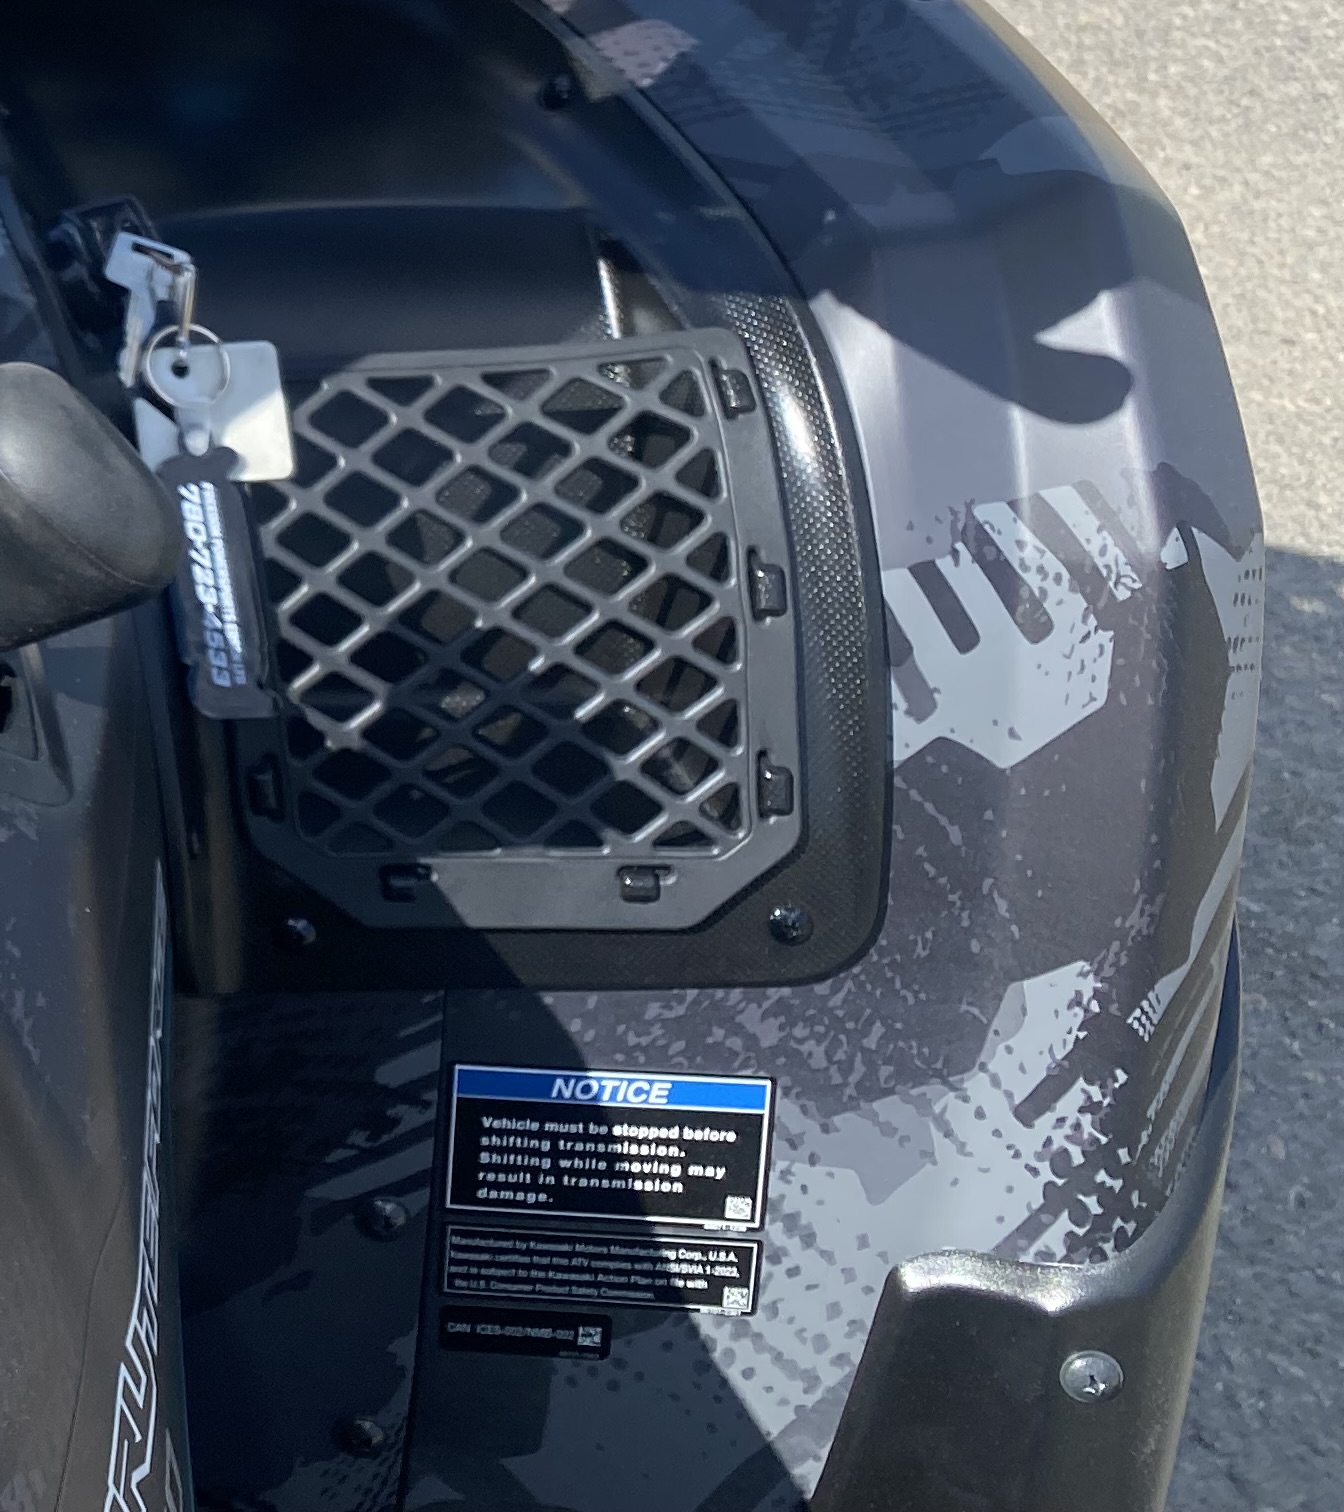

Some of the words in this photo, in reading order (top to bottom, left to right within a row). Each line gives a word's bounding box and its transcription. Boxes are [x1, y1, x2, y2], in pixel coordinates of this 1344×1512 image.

[551, 1078, 672, 1104] NOTICE
[482, 1117, 539, 1130] Vehicle
[544, 1122, 583, 1132] must
[588, 1122, 608, 1134] be
[612, 1123, 679, 1139] stopped
[682, 1126, 736, 1142] before
[481, 1135, 550, 1151] shifting
[558, 1140, 685, 1156] transmission.
[479, 1152, 551, 1168] Shifting
[559, 1157, 606, 1169] while
[615, 1161, 681, 1177] moving
[687, 1165, 726, 1179] may
[478, 1172, 530, 1183] result
[538, 1173, 554, 1184] in
[563, 1176, 683, 1192] transmission
[476, 1188, 553, 1203] damage.
